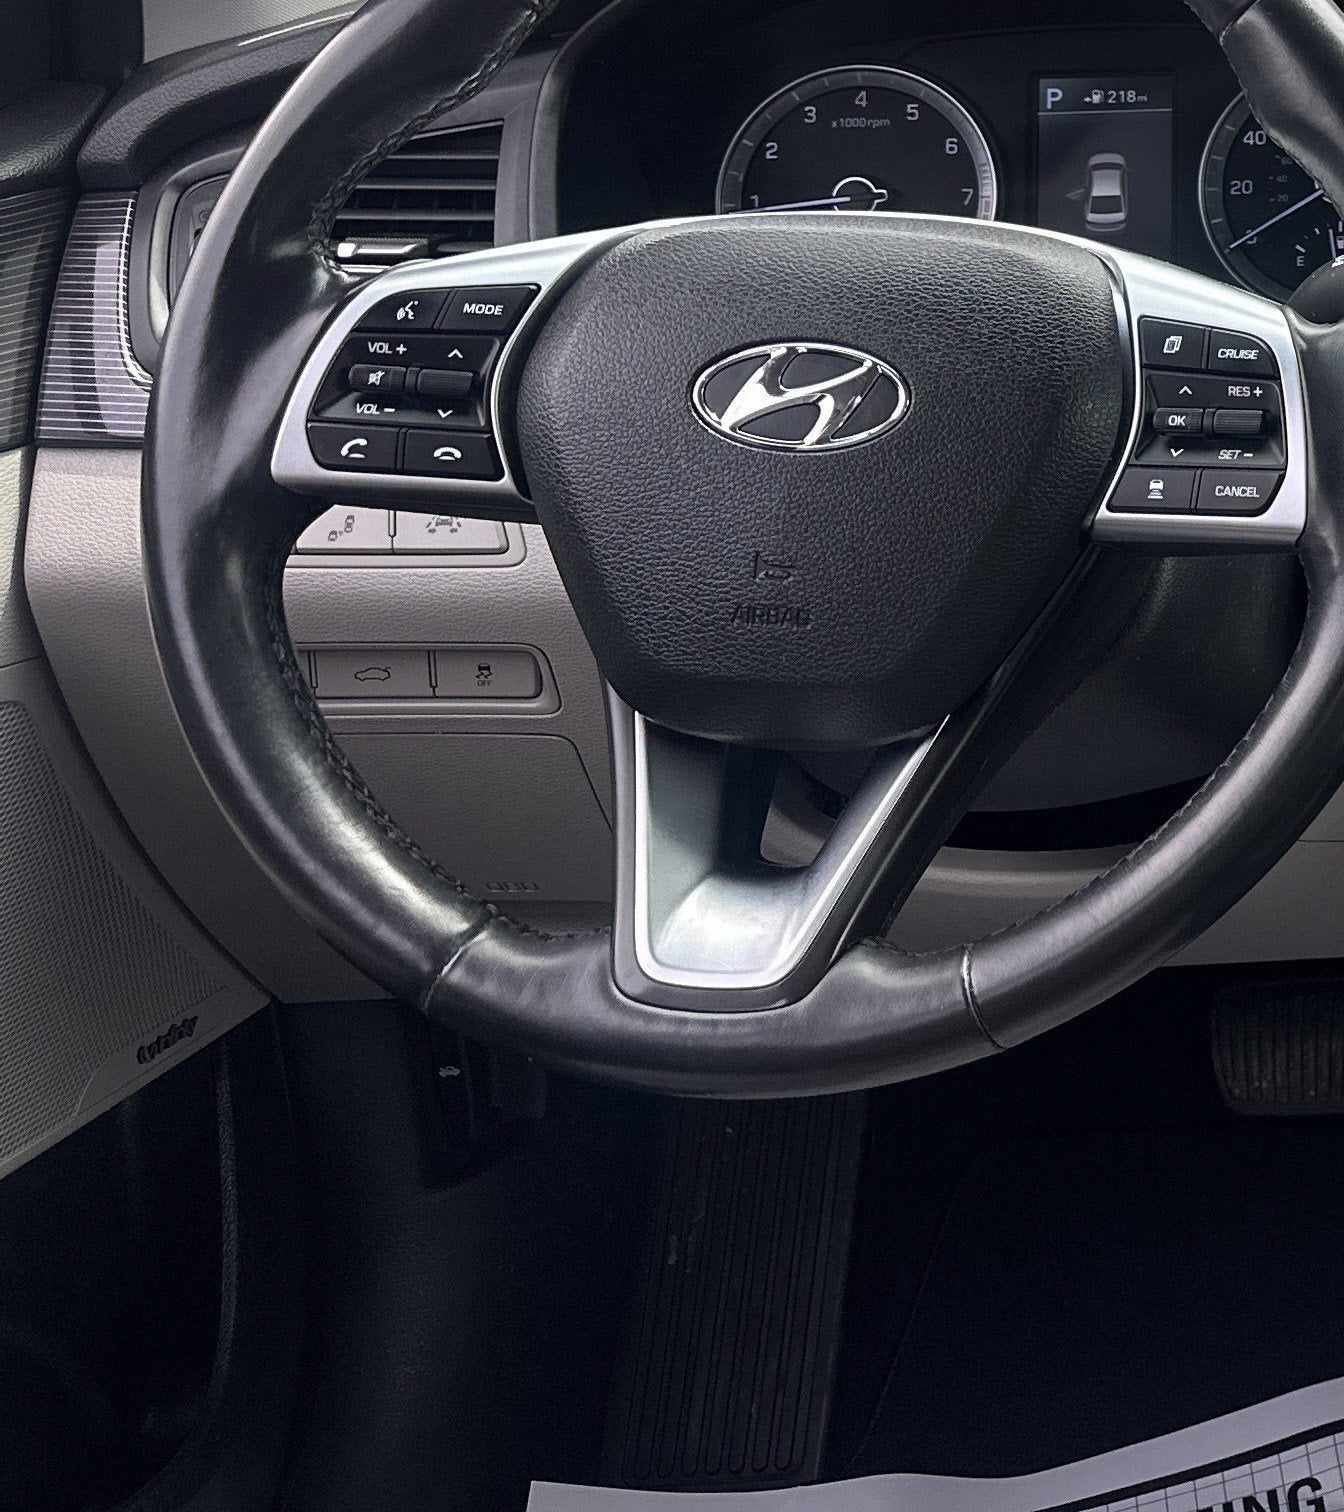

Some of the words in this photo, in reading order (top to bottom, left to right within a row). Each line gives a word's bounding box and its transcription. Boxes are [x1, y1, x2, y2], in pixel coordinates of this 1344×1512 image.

[855, 90, 868, 108] 4
[1046, 88, 1063, 109] P
[804, 106, 817, 123] 3
[906, 103, 919, 121] 5
[1243, 130, 1267, 146] 40
[765, 142, 778, 160] 2
[945, 138, 958, 155] 6
[1229, 180, 1253, 196] 20
[750, 194, 759, 208] 1
[961, 188, 973, 206] 7
[1297, 256, 1305, 267] E
[463, 302, 504, 316] MODE
[367, 341, 393, 355] VOL
[1217, 348, 1260, 360] CRUISE
[1227, 385, 1251, 397] RES
[355, 403, 381, 415] VOL
[1168, 414, 1187, 426] OK
[1218, 449, 1242, 460] SET
[1214, 485, 1260, 498] CANCEL
[730, 605, 811, 627] AIRBAG
[476, 678, 493, 687] OFF
